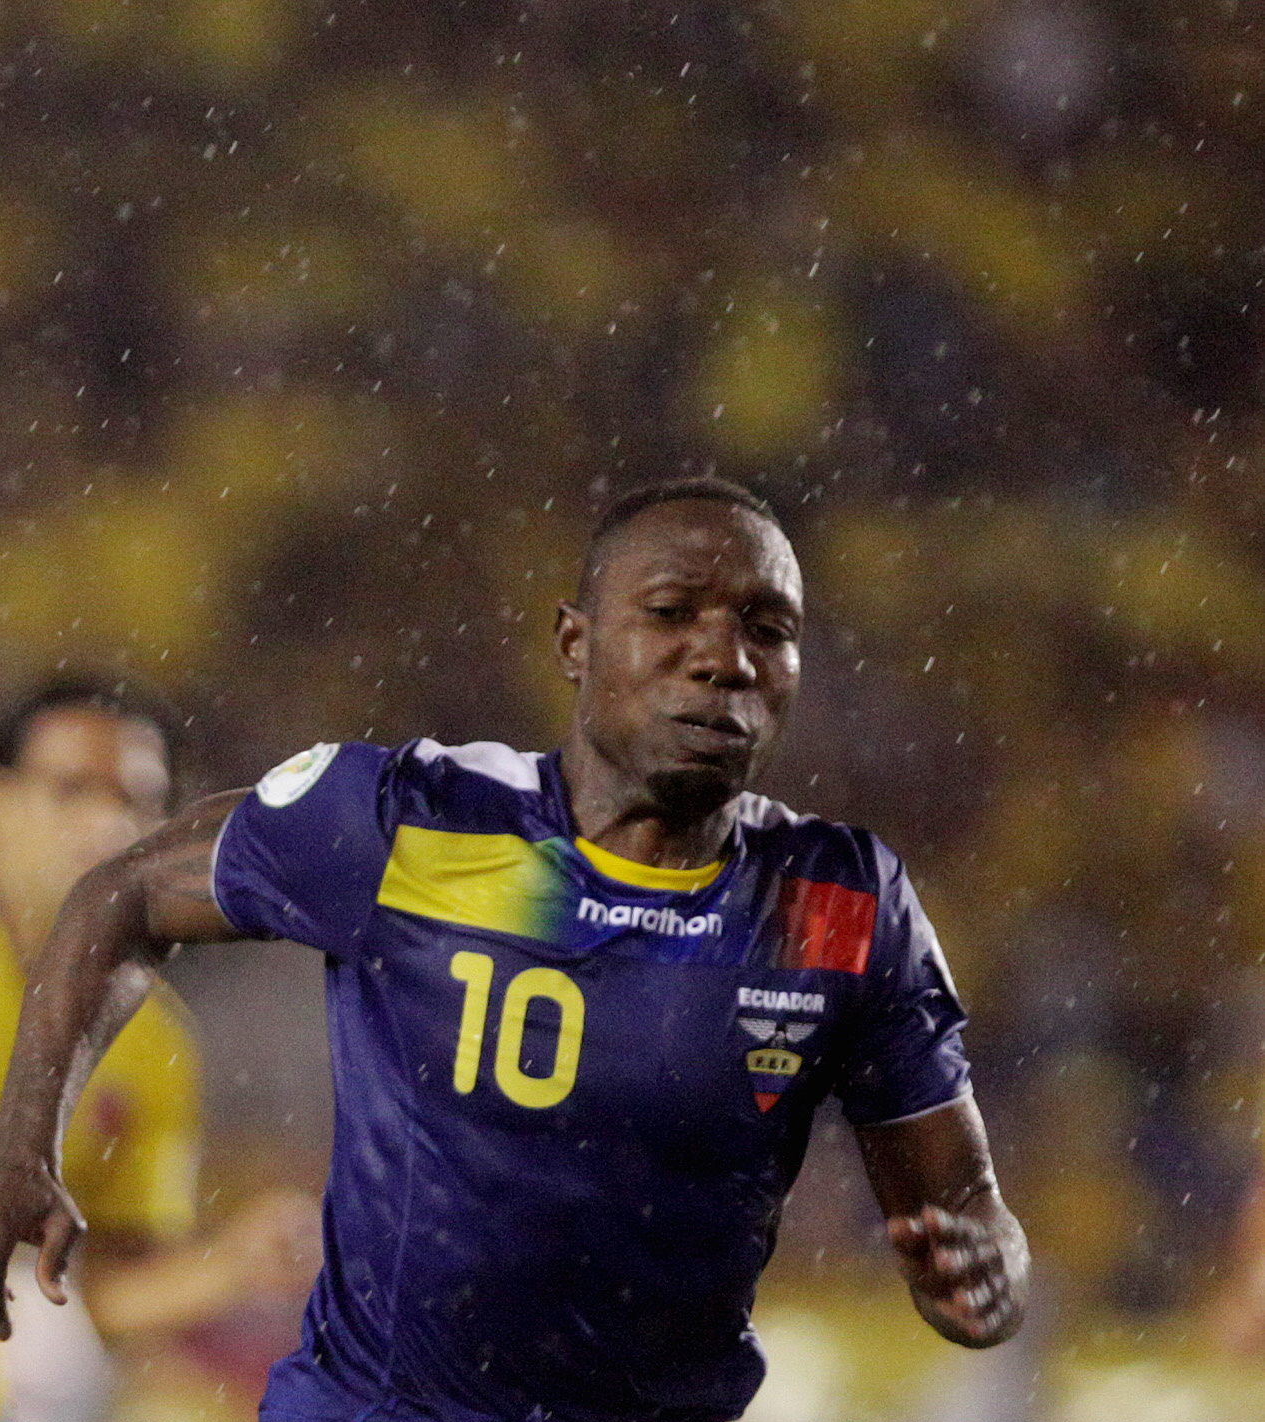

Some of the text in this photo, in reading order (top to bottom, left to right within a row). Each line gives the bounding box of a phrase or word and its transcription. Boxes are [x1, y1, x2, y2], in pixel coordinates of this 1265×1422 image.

[577, 897, 722, 937] marathon
[738, 987, 825, 1012] ECUADOR
[450, 951, 585, 1108] 10
